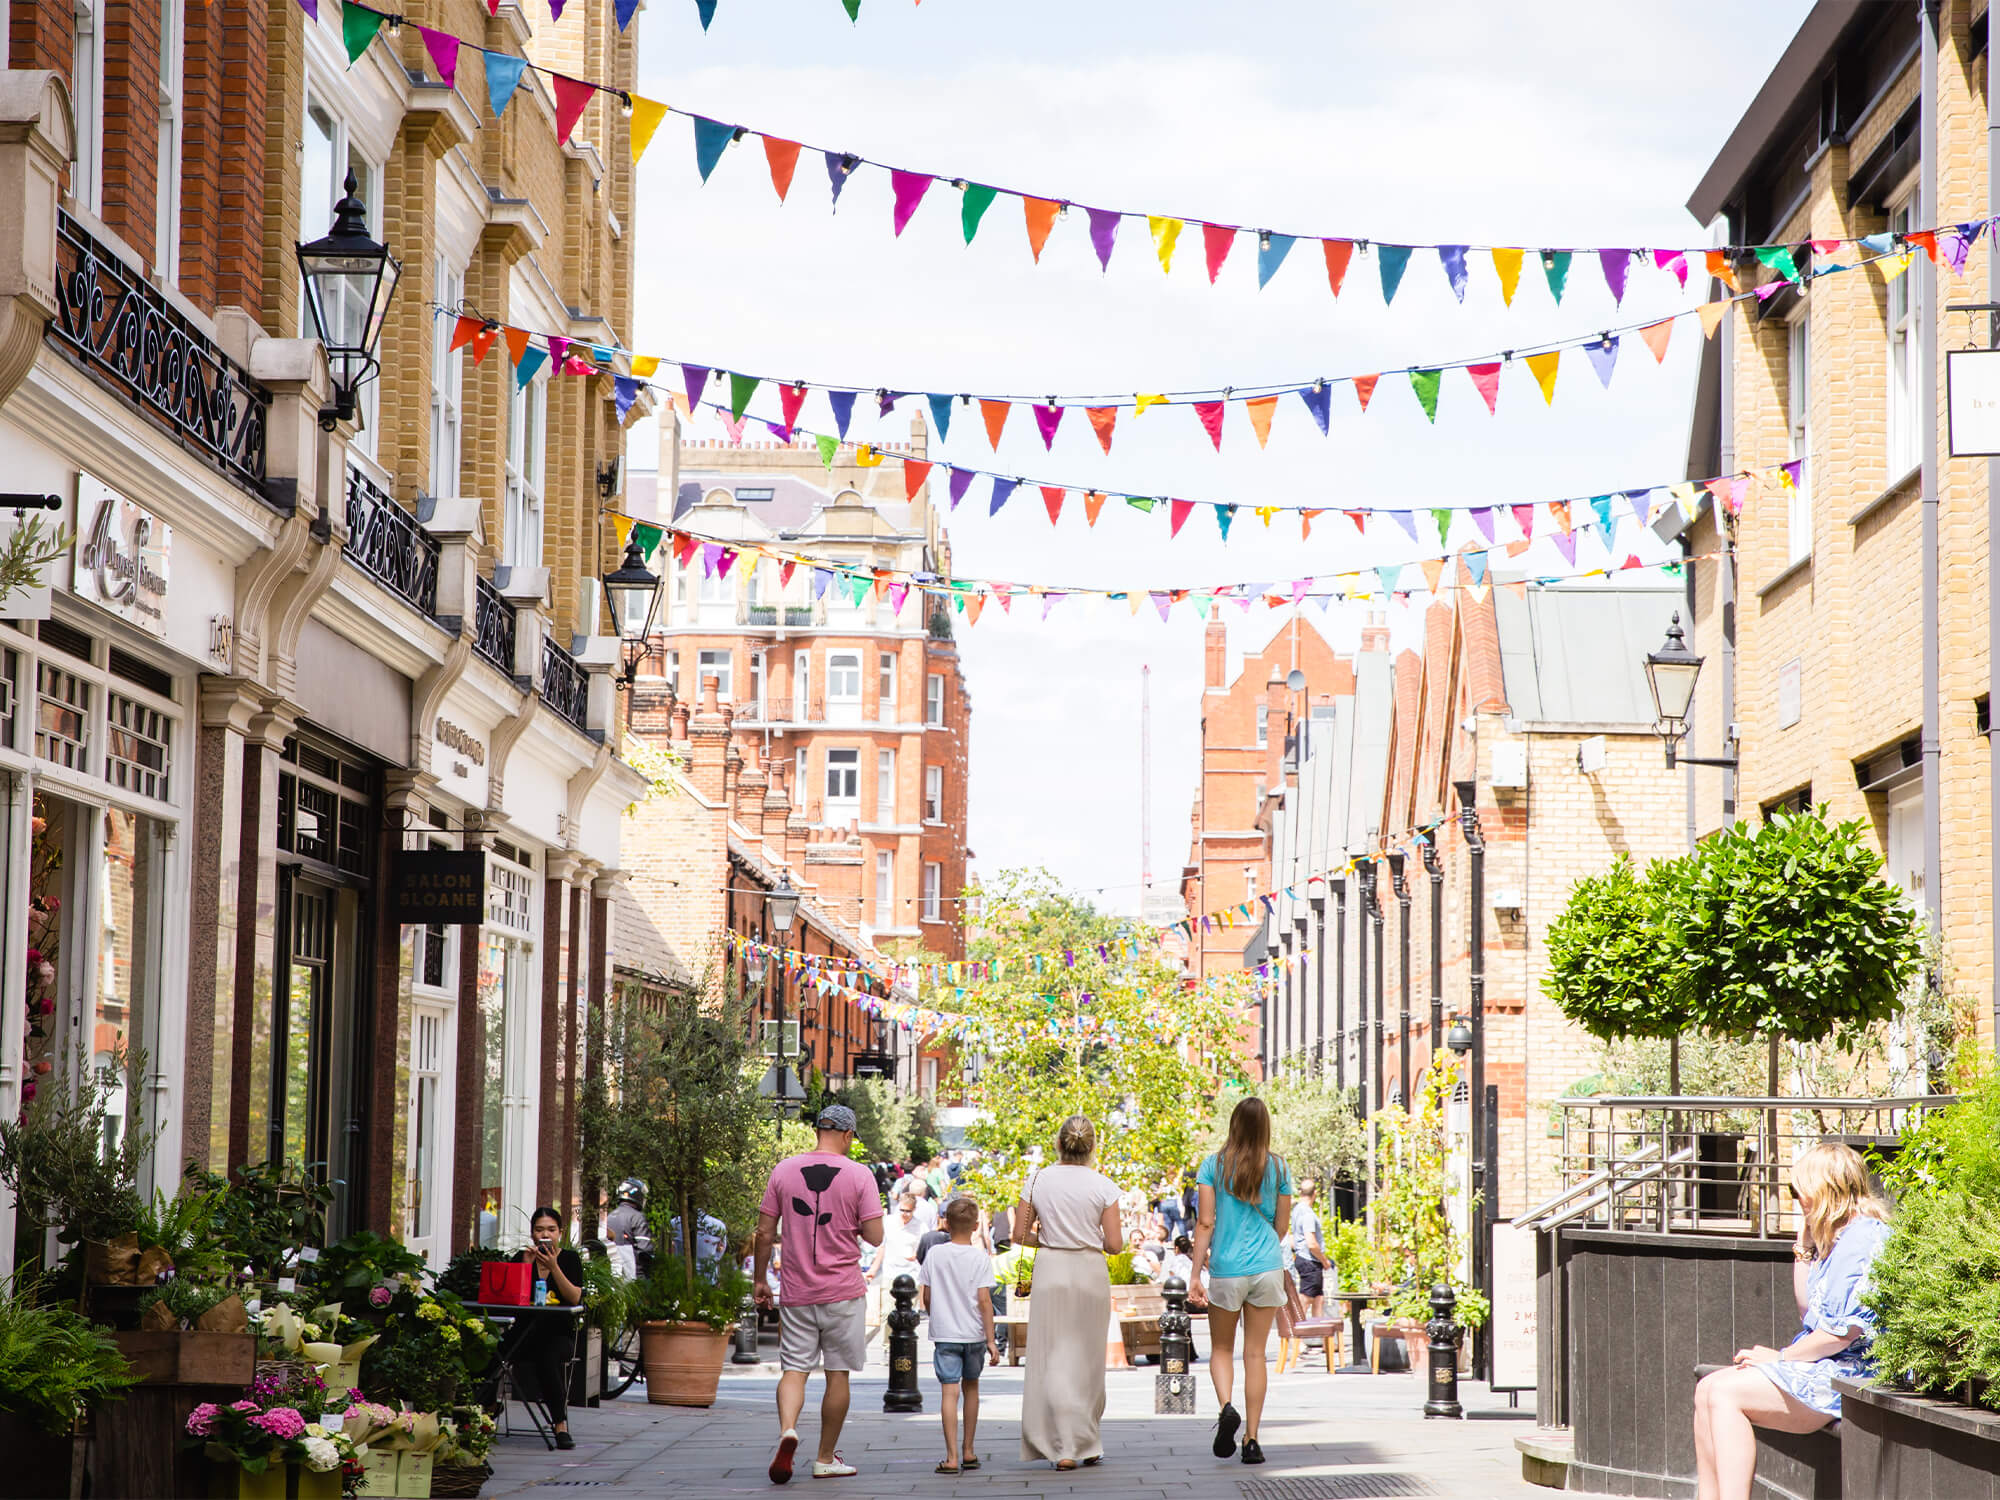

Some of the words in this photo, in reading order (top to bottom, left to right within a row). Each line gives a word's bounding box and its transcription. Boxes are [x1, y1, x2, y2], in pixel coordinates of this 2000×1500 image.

[406, 873, 472, 889] SALON
[399, 892, 478, 907] SLOANE
[1514, 1311, 1521, 1321] 2
